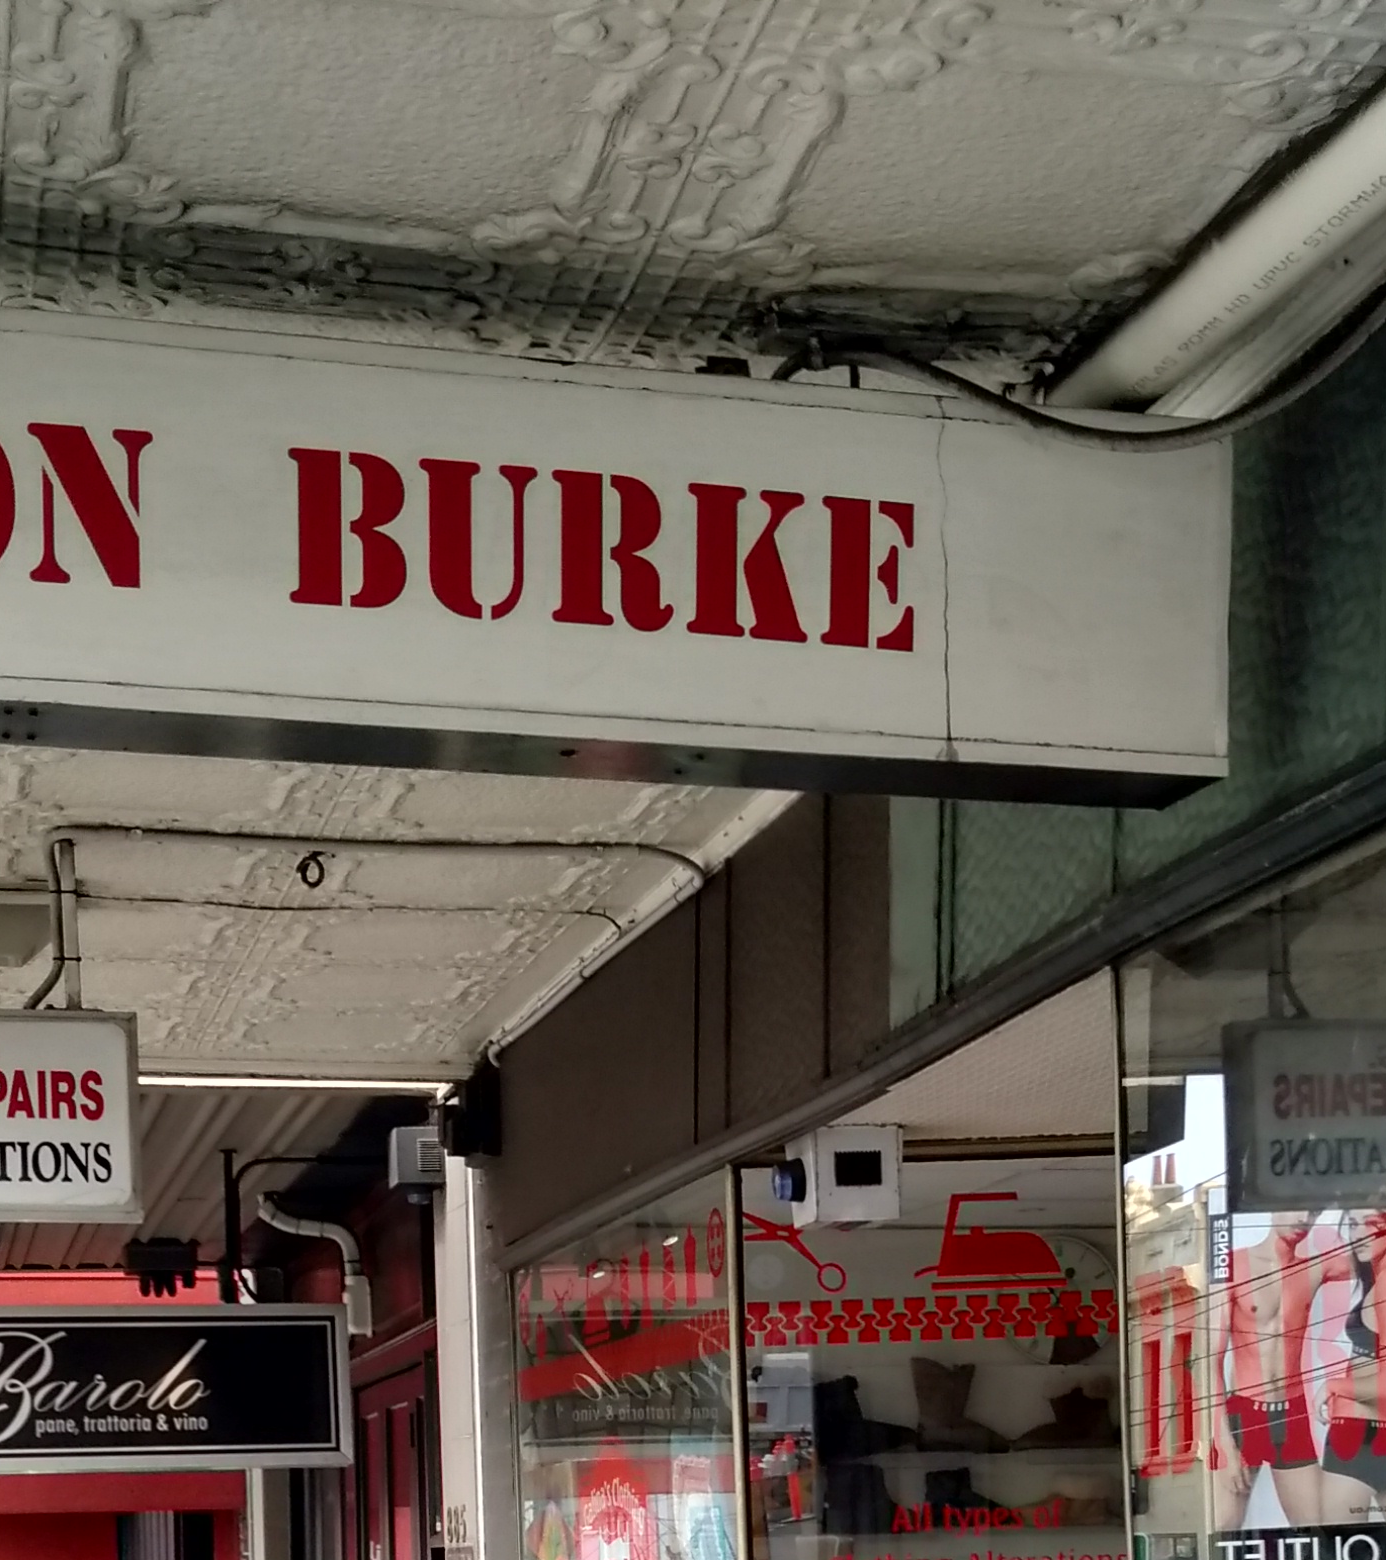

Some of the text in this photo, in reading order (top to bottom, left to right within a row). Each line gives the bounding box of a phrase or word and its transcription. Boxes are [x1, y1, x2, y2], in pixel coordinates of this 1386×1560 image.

[289, 447, 914, 652] BURKE
[35, 1414, 209, 1438] pane, trattoria & vino
[891, 1499, 1064, 1537] All types of
